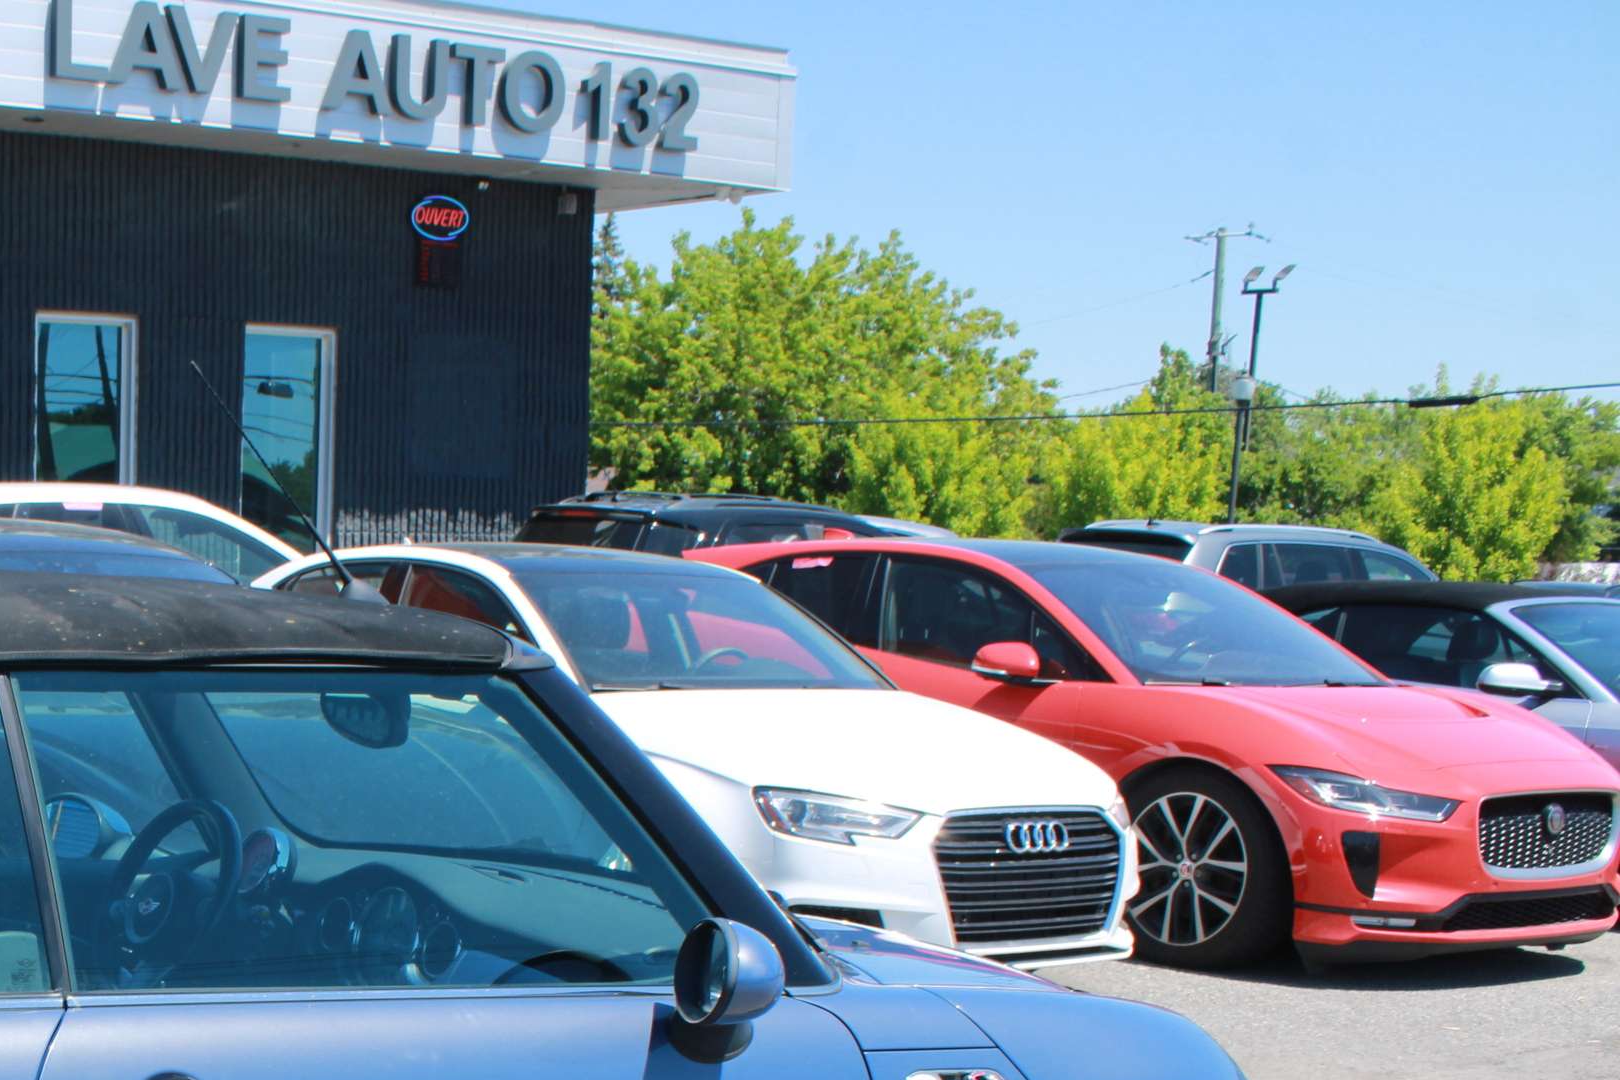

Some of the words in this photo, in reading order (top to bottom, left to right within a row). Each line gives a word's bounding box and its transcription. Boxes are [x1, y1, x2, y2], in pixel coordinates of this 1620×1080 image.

[49, 0, 292, 103] LAVE
[319, 28, 566, 134] AUTO
[579, 61, 700, 152] 132
[415, 206, 465, 229] OUVERT
